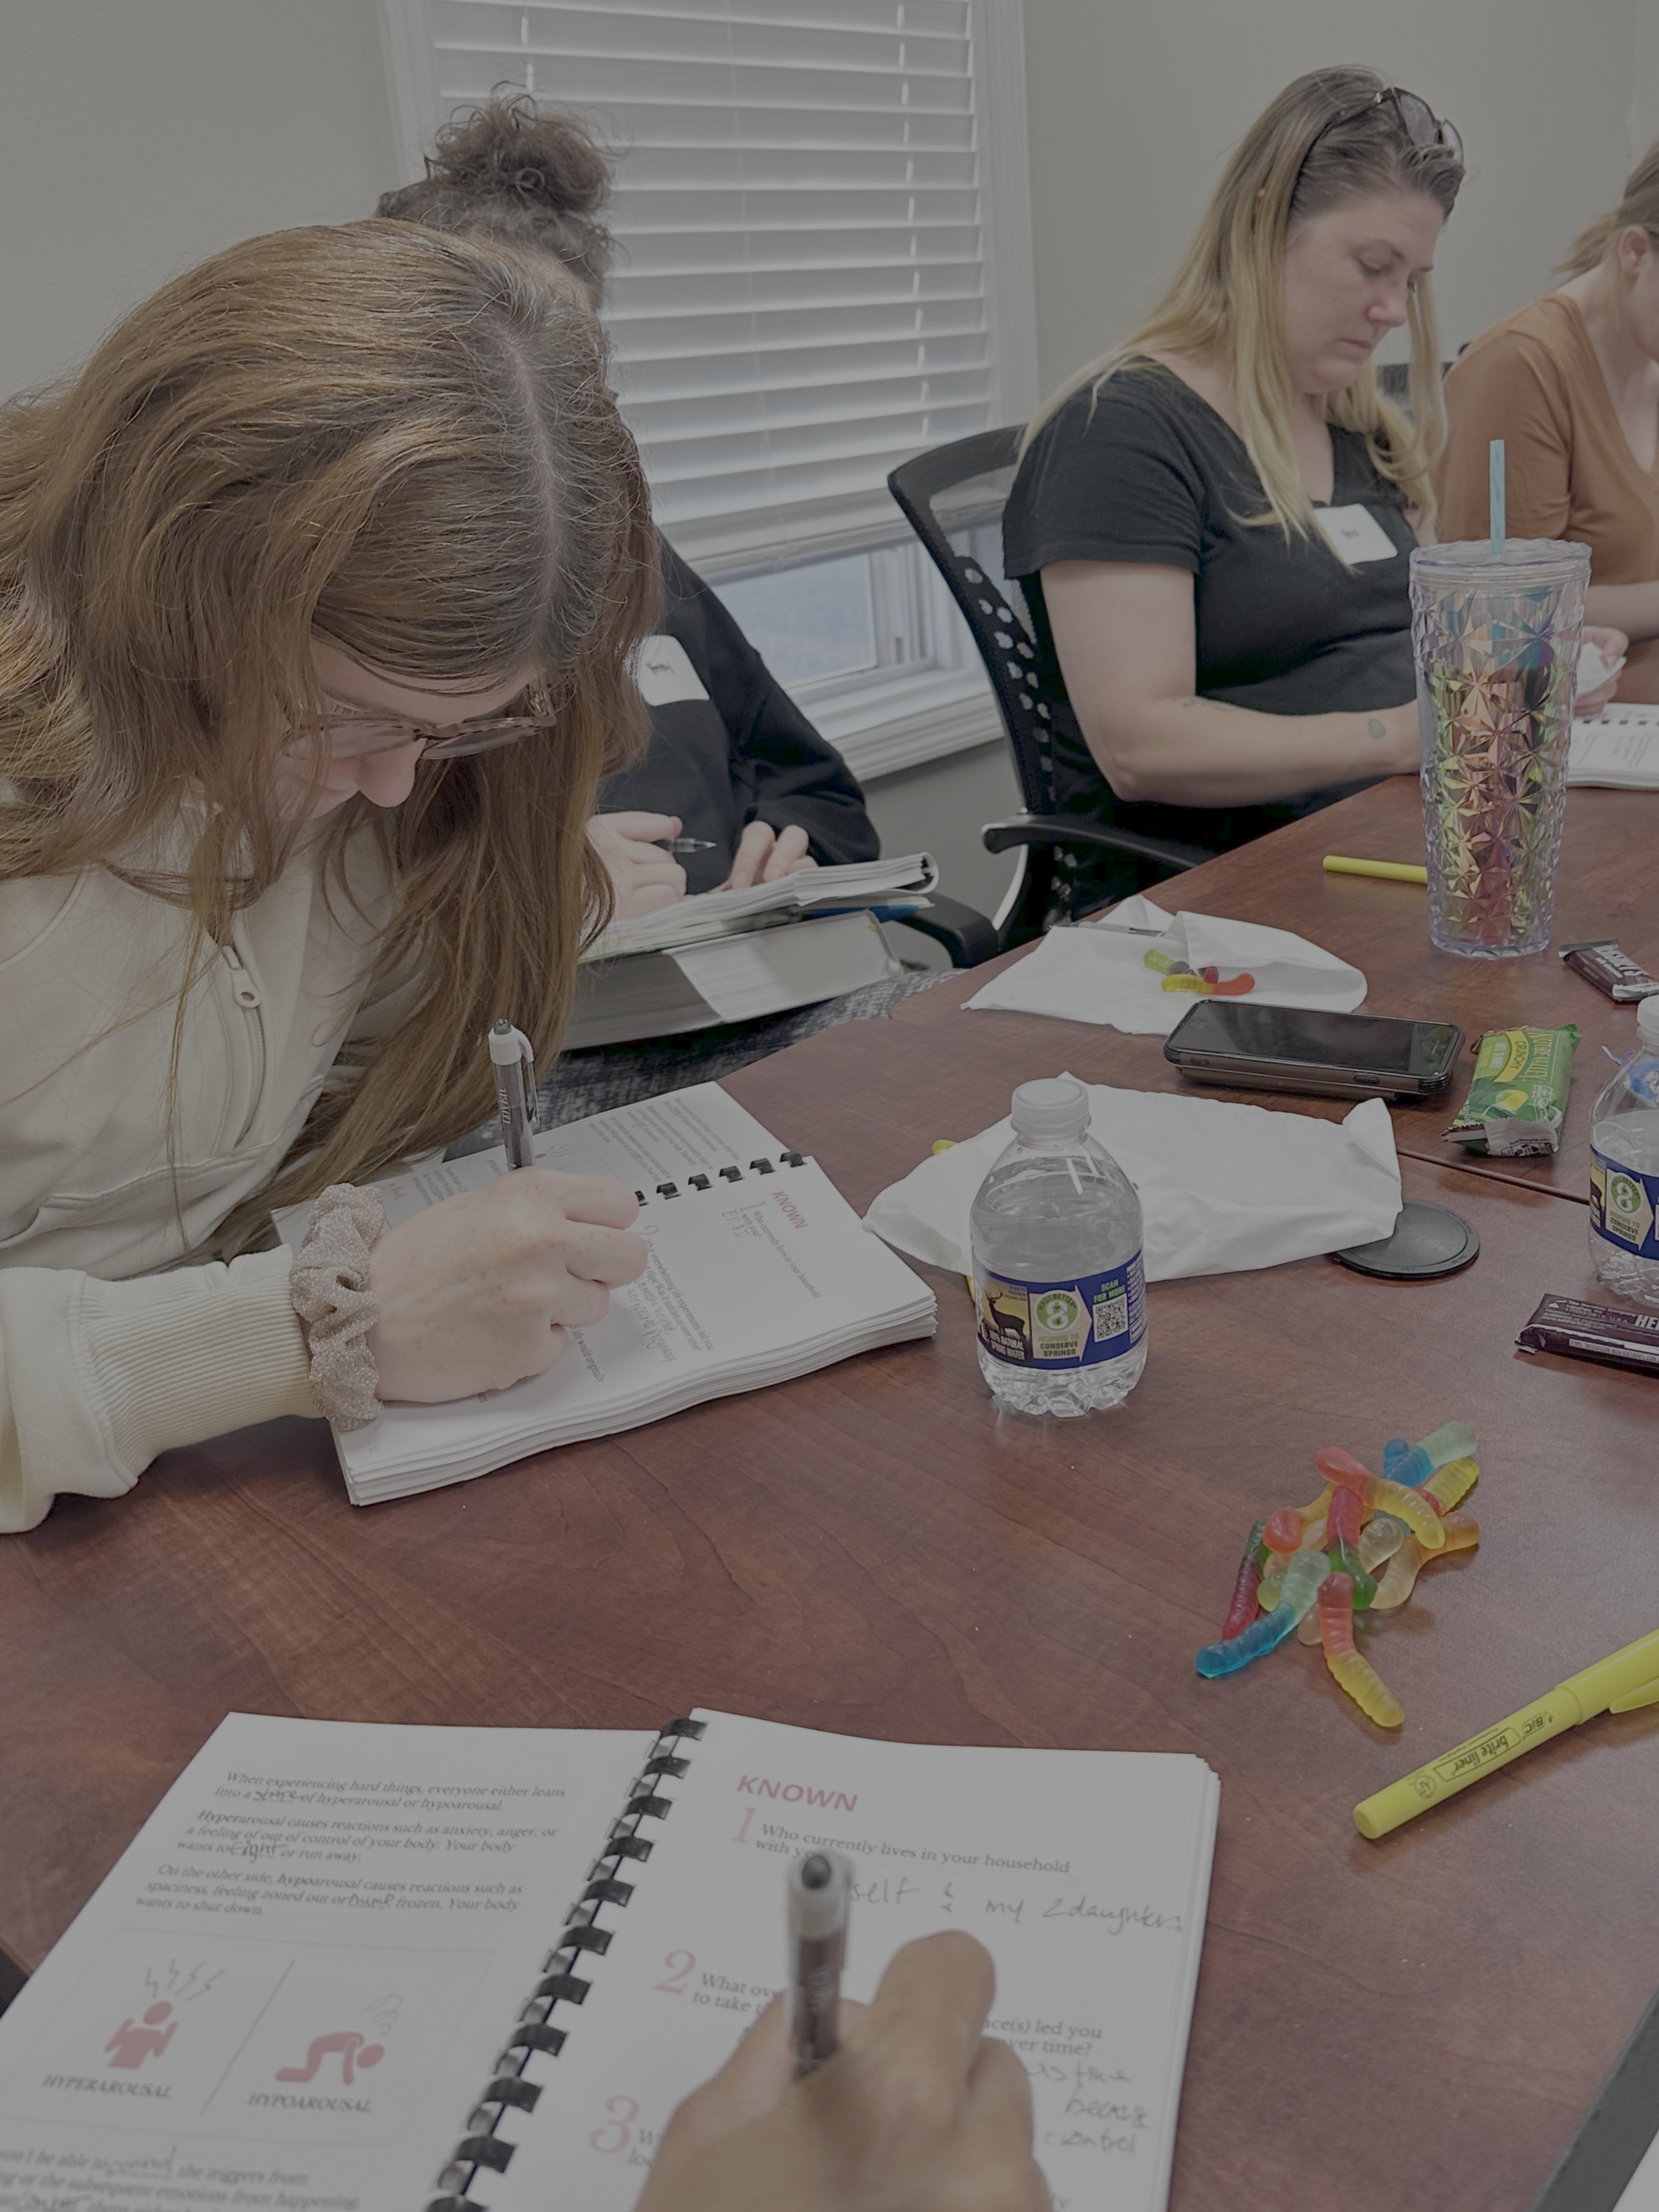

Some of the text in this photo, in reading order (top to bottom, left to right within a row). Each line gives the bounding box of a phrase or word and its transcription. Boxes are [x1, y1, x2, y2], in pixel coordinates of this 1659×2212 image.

[1509, 1040, 1528, 1070] CRUNCHY
[742, 1214, 753, 1225] with
[772, 1191, 808, 1229] KNOWN
[752, 1210, 763, 1224] Who
[761, 1224, 779, 1245] currently
[776, 1245, 787, 1257] lives
[788, 1263, 800, 1274] your
[798, 1273, 822, 1298] household
[1093, 1291, 1107, 1303] FOR
[1101, 1279, 1118, 1291] SCAN
[1040, 1341, 1078, 1349] CONSERVE
[1043, 1348, 1076, 1357] SPRINGS
[578, 1340, 593, 1357] would
[586, 1357, 605, 1383] originally
[1481, 1735, 1509, 1758] brite
[214, 1785, 241, 1799] into
[301, 1792, 317, 1804] of
[317, 1792, 402, 1808] hyperarousal
[403, 1799, 419, 1808] or
[228, 1772, 566, 1799] When experiencing hard things, everyone either leans
[737, 1774, 858, 1812] KNOWN
[198, 1809, 286, 1827] Hyperarousal
[287, 1819, 328, 1830] causes
[331, 1820, 390, 1833] reactions
[393, 1822, 423, 1834] such
[425, 1826, 439, 1835] as
[496, 1827, 537, 1839] anger,
[542, 1828, 558, 1837] or
[731, 1807, 755, 1844] 1
[177, 1840, 215, 1852] wants
[216, 1844, 230, 1853] to
[281, 1848, 297, 1857] or
[299, 1850, 322, 1860] run
[325, 1850, 362, 1863] away.
[186, 1825, 516, 1854] a feeling of out of control of your body. Your body
[756, 1839, 789, 1855] with
[763, 1823, 1071, 1874] Who currently lives in your household
[158, 1863, 522, 1894] On the other side, hypoarousal causes reactions such as
[135, 1896, 173, 1908] wants
[175, 1899, 190, 1910] to
[192, 1900, 221, 1913] shut
[146, 1881, 208, 1895] spaciness,
[213, 1885, 260, 1901] feeling
[261, 1888, 304, 1903] zoned
[306, 1892, 329, 1904] out
[331, 1895, 349, 1906] or
[448, 1898, 482, 1910] Your
[484, 1898, 521, 1913] body
[985, 1899, 1025, 1923] my
[652, 1949, 696, 1994] 2
[701, 1972, 747, 1994] What
[693, 1992, 711, 2004] to
[715, 1996, 752, 2013] take
[1035, 2020, 1063, 2035] led
[1066, 2025, 1102, 2040] you
[1042, 2039, 1092, 2056] time?
[42, 2072, 172, 2099] HYPERAROUSAL
[247, 2092, 372, 2113] HYPOAROUSAL
[589, 2095, 641, 2155] 3
